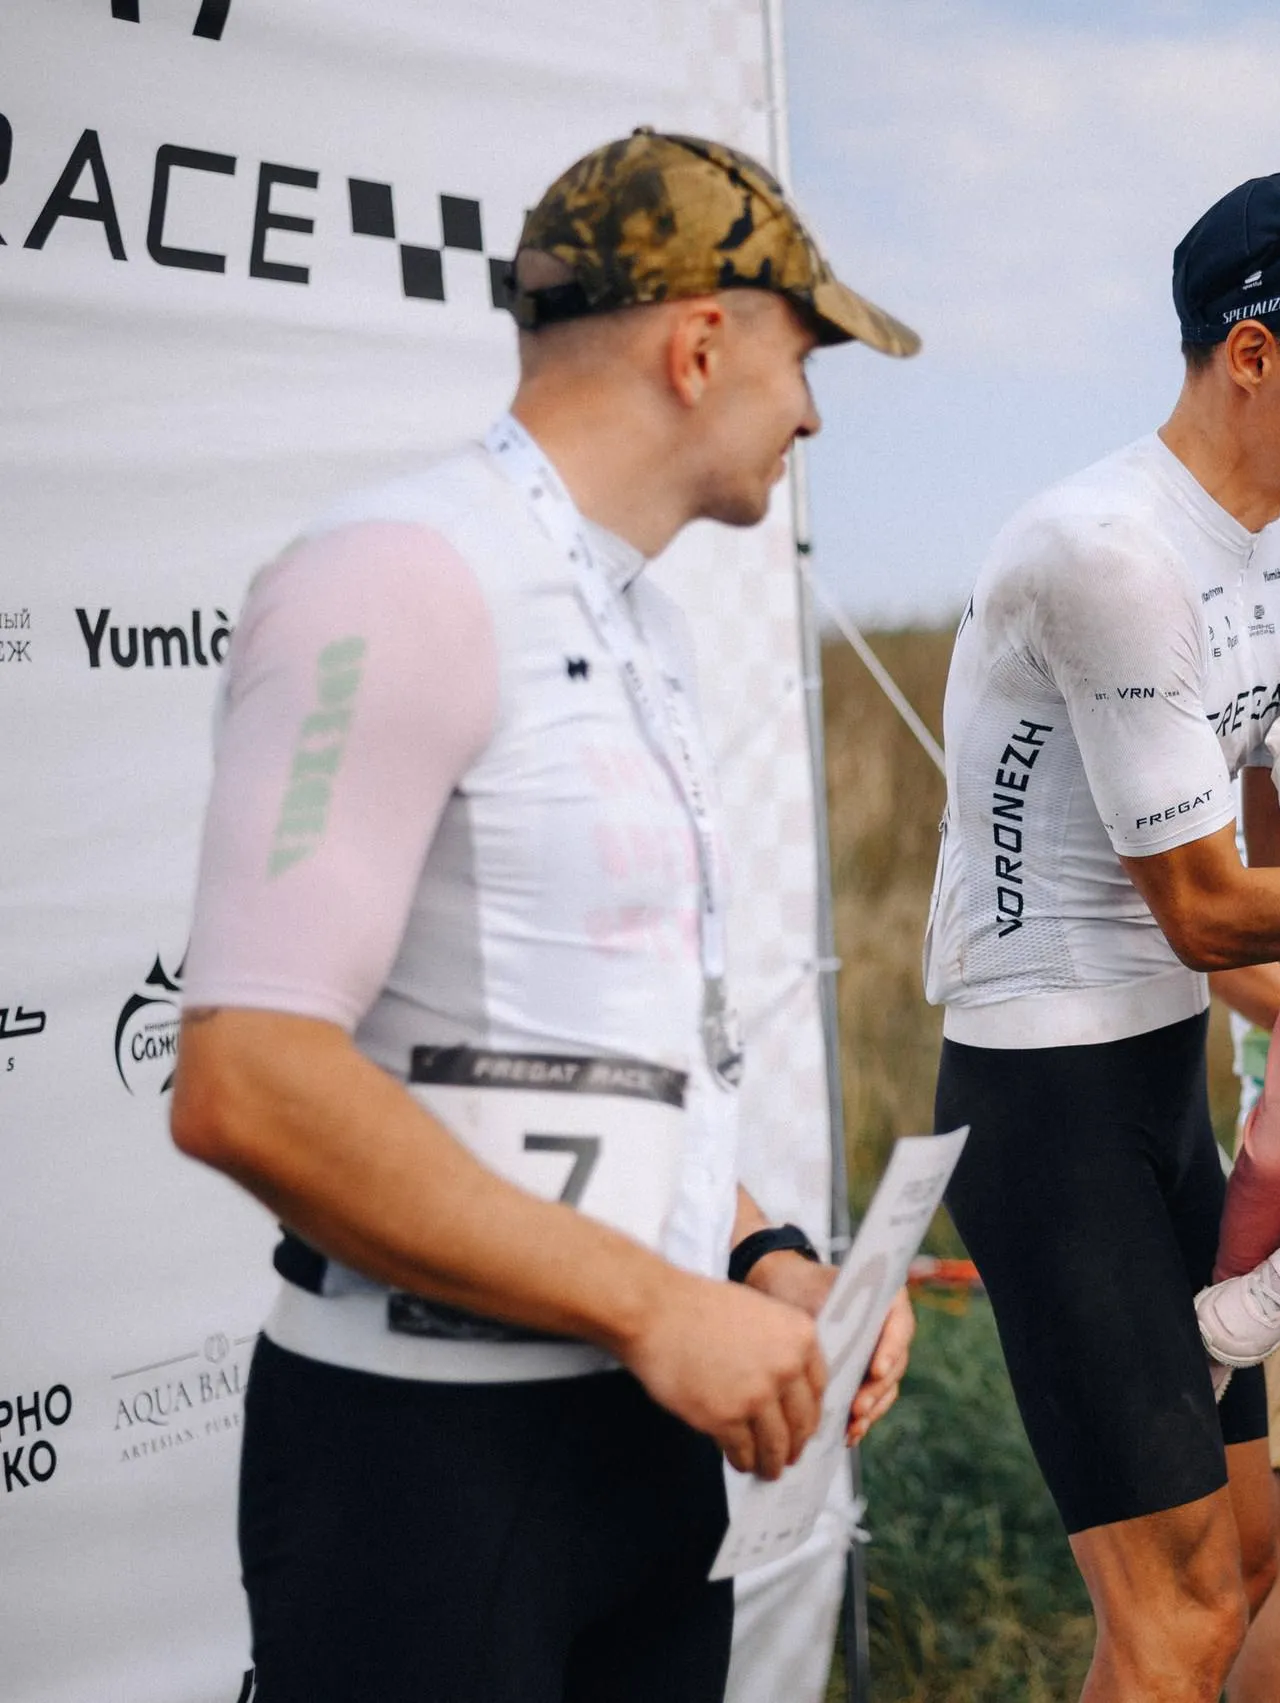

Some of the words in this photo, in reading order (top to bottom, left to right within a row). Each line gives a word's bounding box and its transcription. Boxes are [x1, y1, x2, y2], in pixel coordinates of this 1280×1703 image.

[0, 607, 31, 629] ЫЙ
[1117, 687, 1155, 699] VRN
[991, 719, 1054, 938] VORONEZH
[1136, 789, 1213, 829] FREGAT
[131, 1031, 180, 1062] Саж
[523, 1133, 604, 1214] 7
[115, 1381, 193, 1431] AQUA
[3, 1440, 57, 1493] КО
